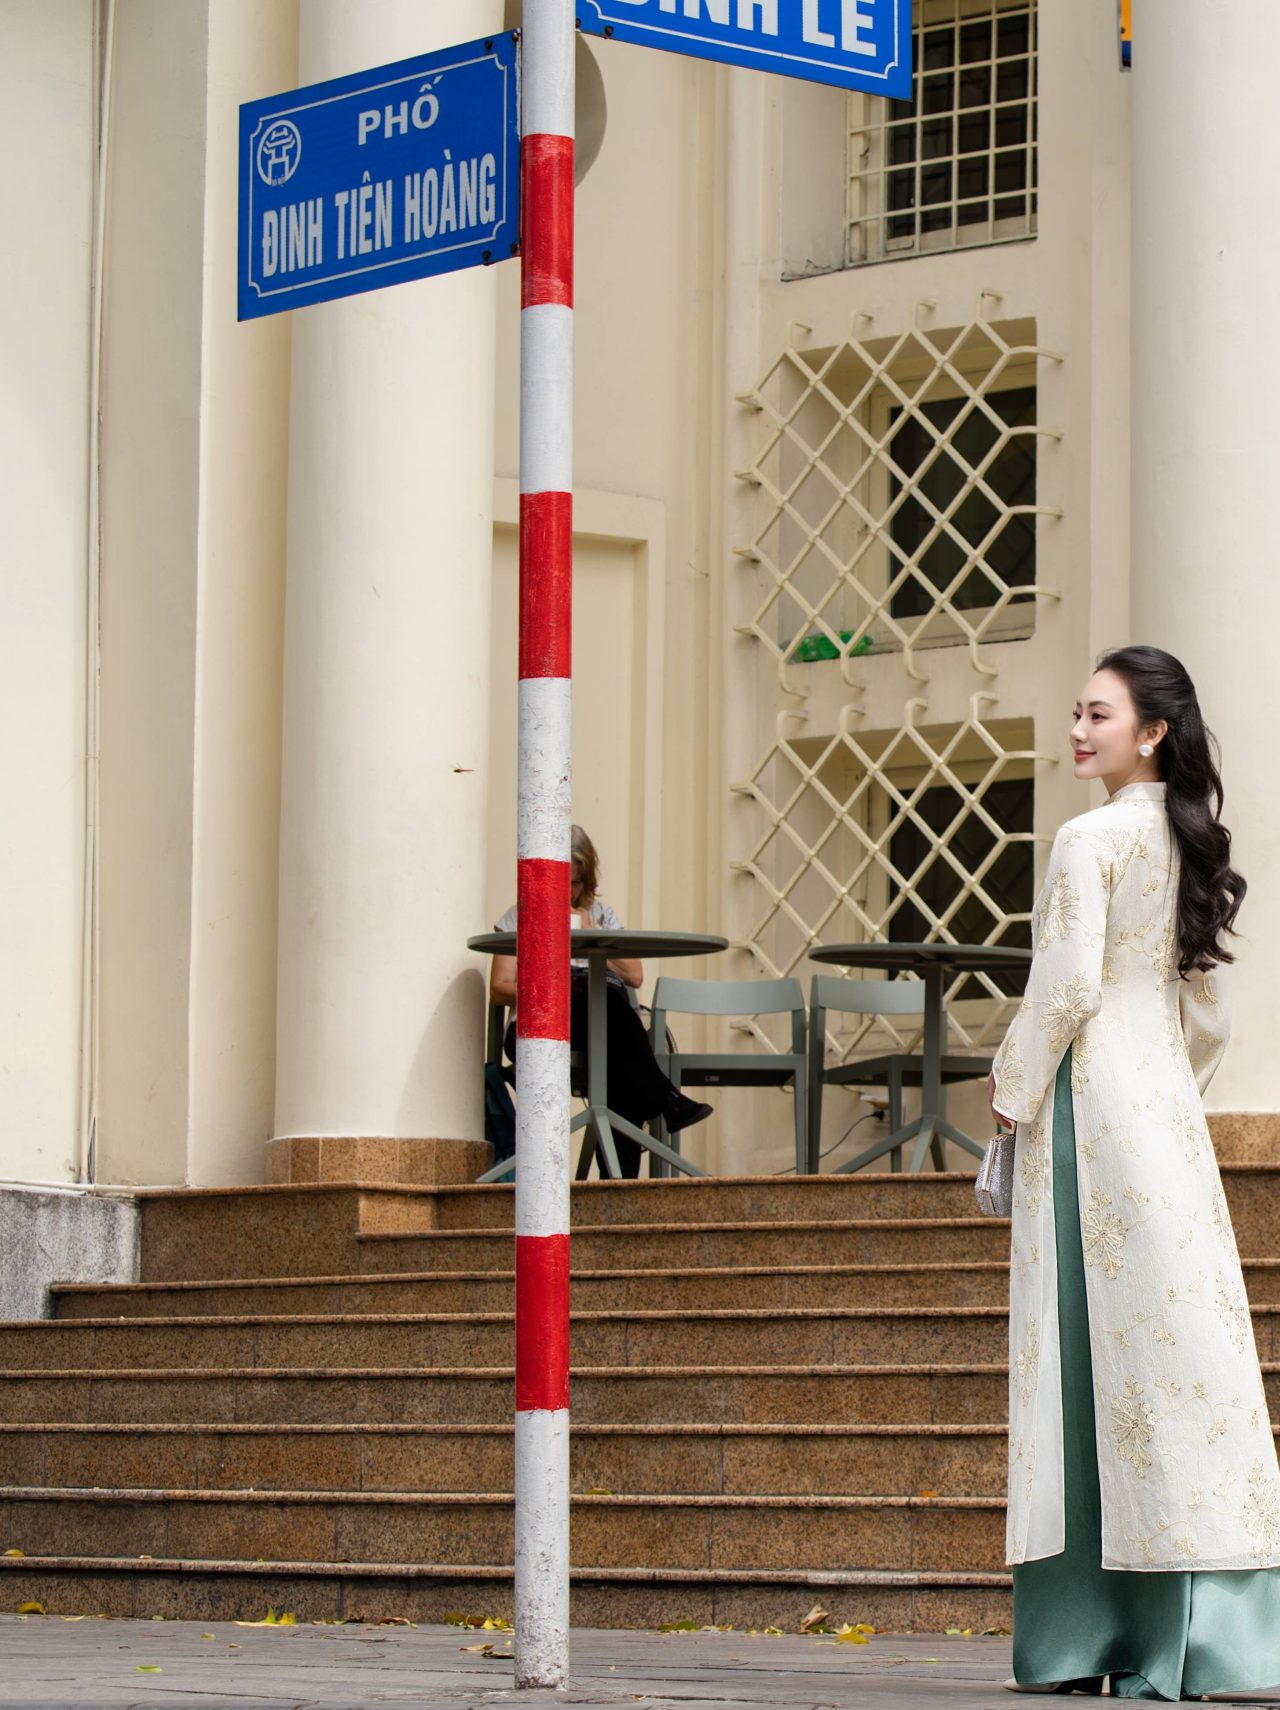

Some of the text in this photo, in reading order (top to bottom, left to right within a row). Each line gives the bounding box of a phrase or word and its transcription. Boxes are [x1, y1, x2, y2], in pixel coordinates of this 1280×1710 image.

[358, 74, 443, 146] PHỐ
[262, 149, 496, 278] ĐINH TIÊN HOÀNG
